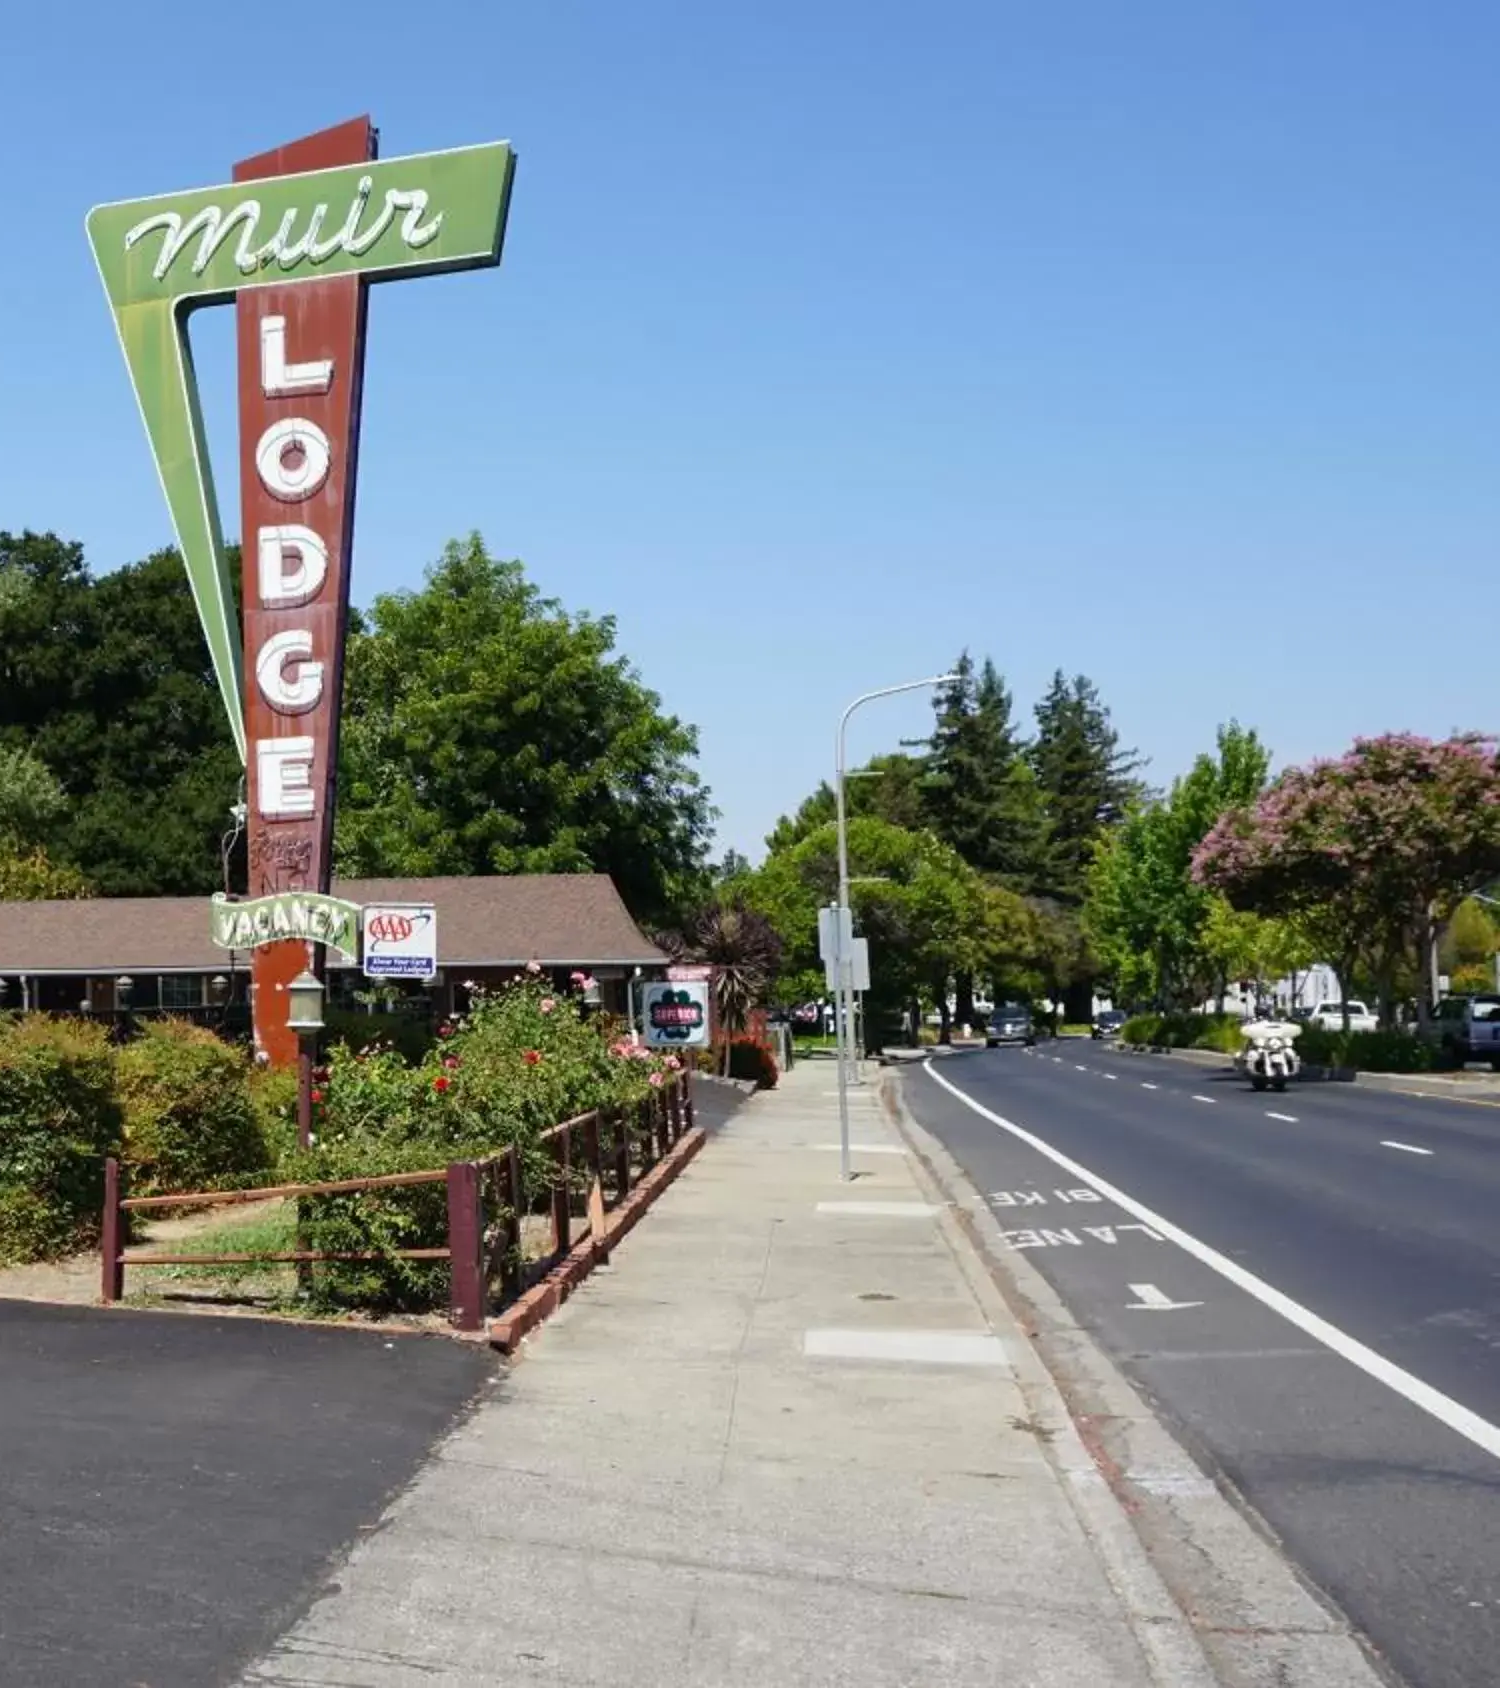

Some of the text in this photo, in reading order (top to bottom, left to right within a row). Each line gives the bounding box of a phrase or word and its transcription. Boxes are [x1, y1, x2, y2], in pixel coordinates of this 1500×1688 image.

[255, 315, 335, 822] LODGE
[220, 900, 350, 944] VACANCY
[370, 914, 410, 942] AAA
[988, 1189, 1102, 1206] BIKE
[997, 1224, 1166, 1249] LANE
